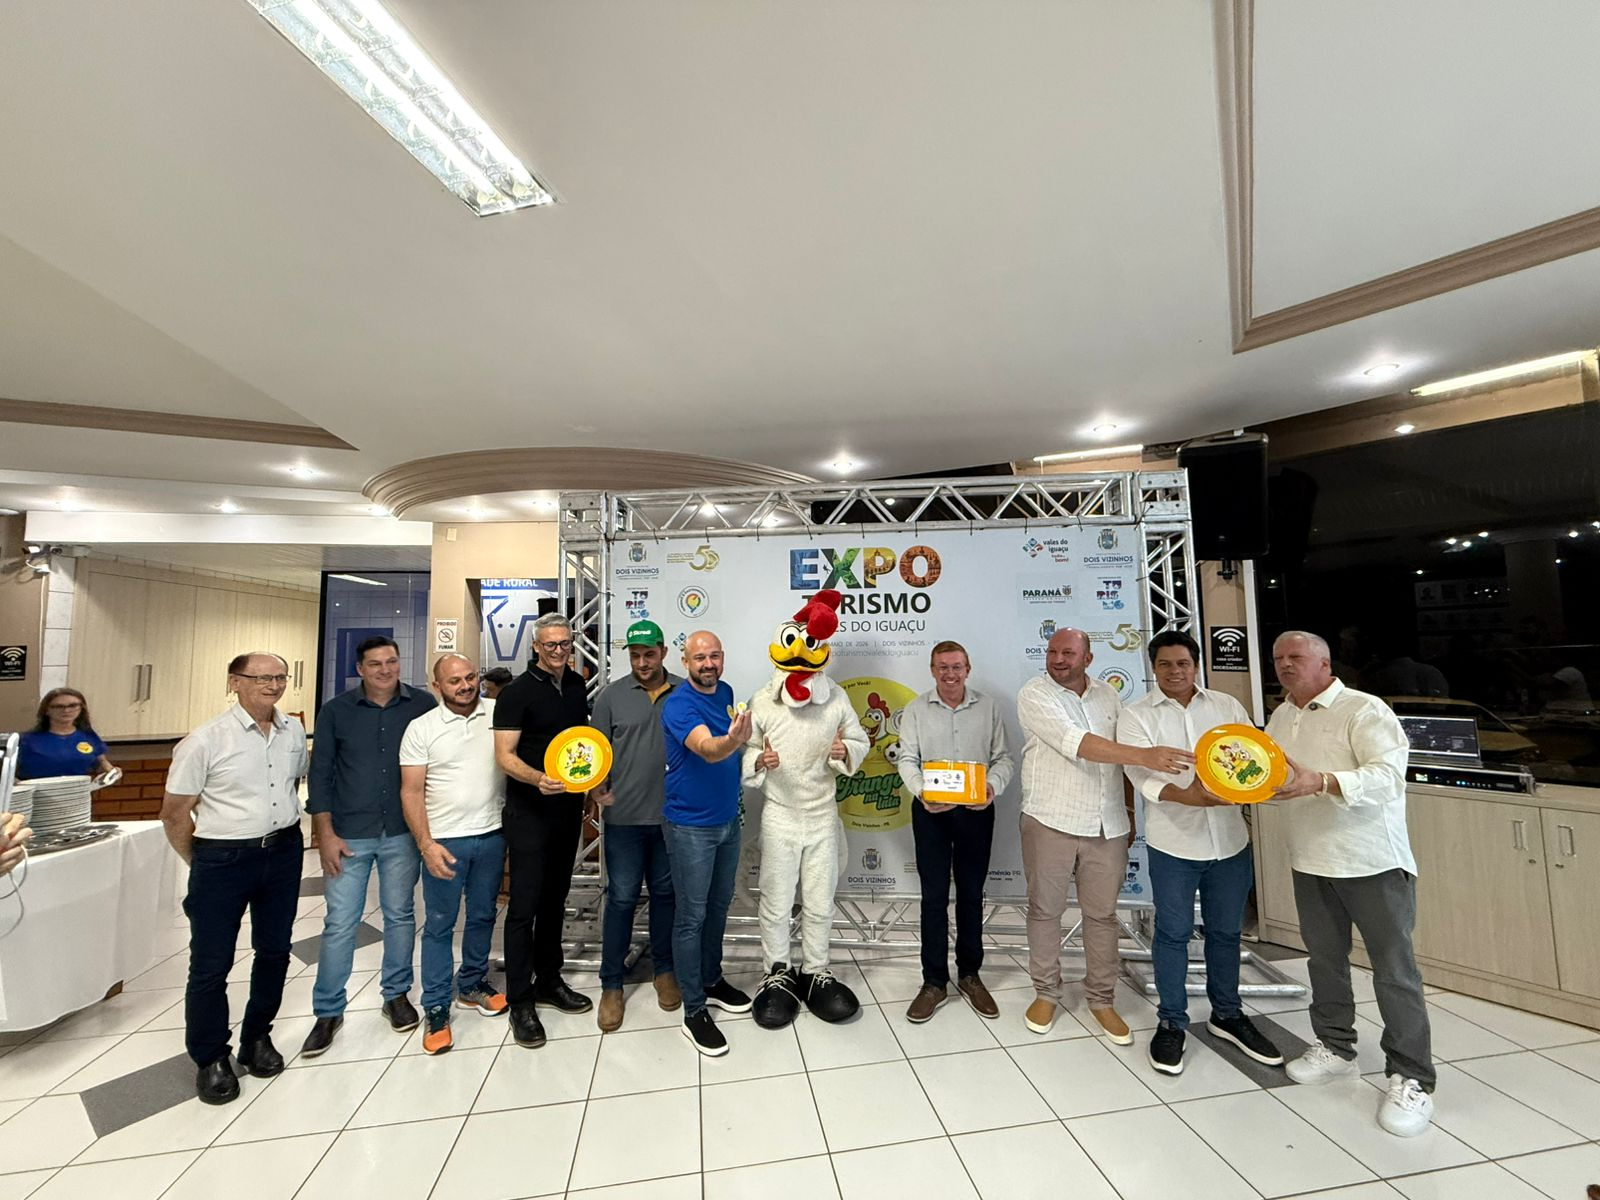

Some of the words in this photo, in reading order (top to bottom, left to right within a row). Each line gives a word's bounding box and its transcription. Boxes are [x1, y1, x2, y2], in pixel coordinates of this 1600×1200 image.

[790, 545, 942, 590] EXPO
[1023, 588, 1062, 597] PARANÁ
[852, 621, 872, 632] DO
[876, 620, 926, 634] IGUAÇU
